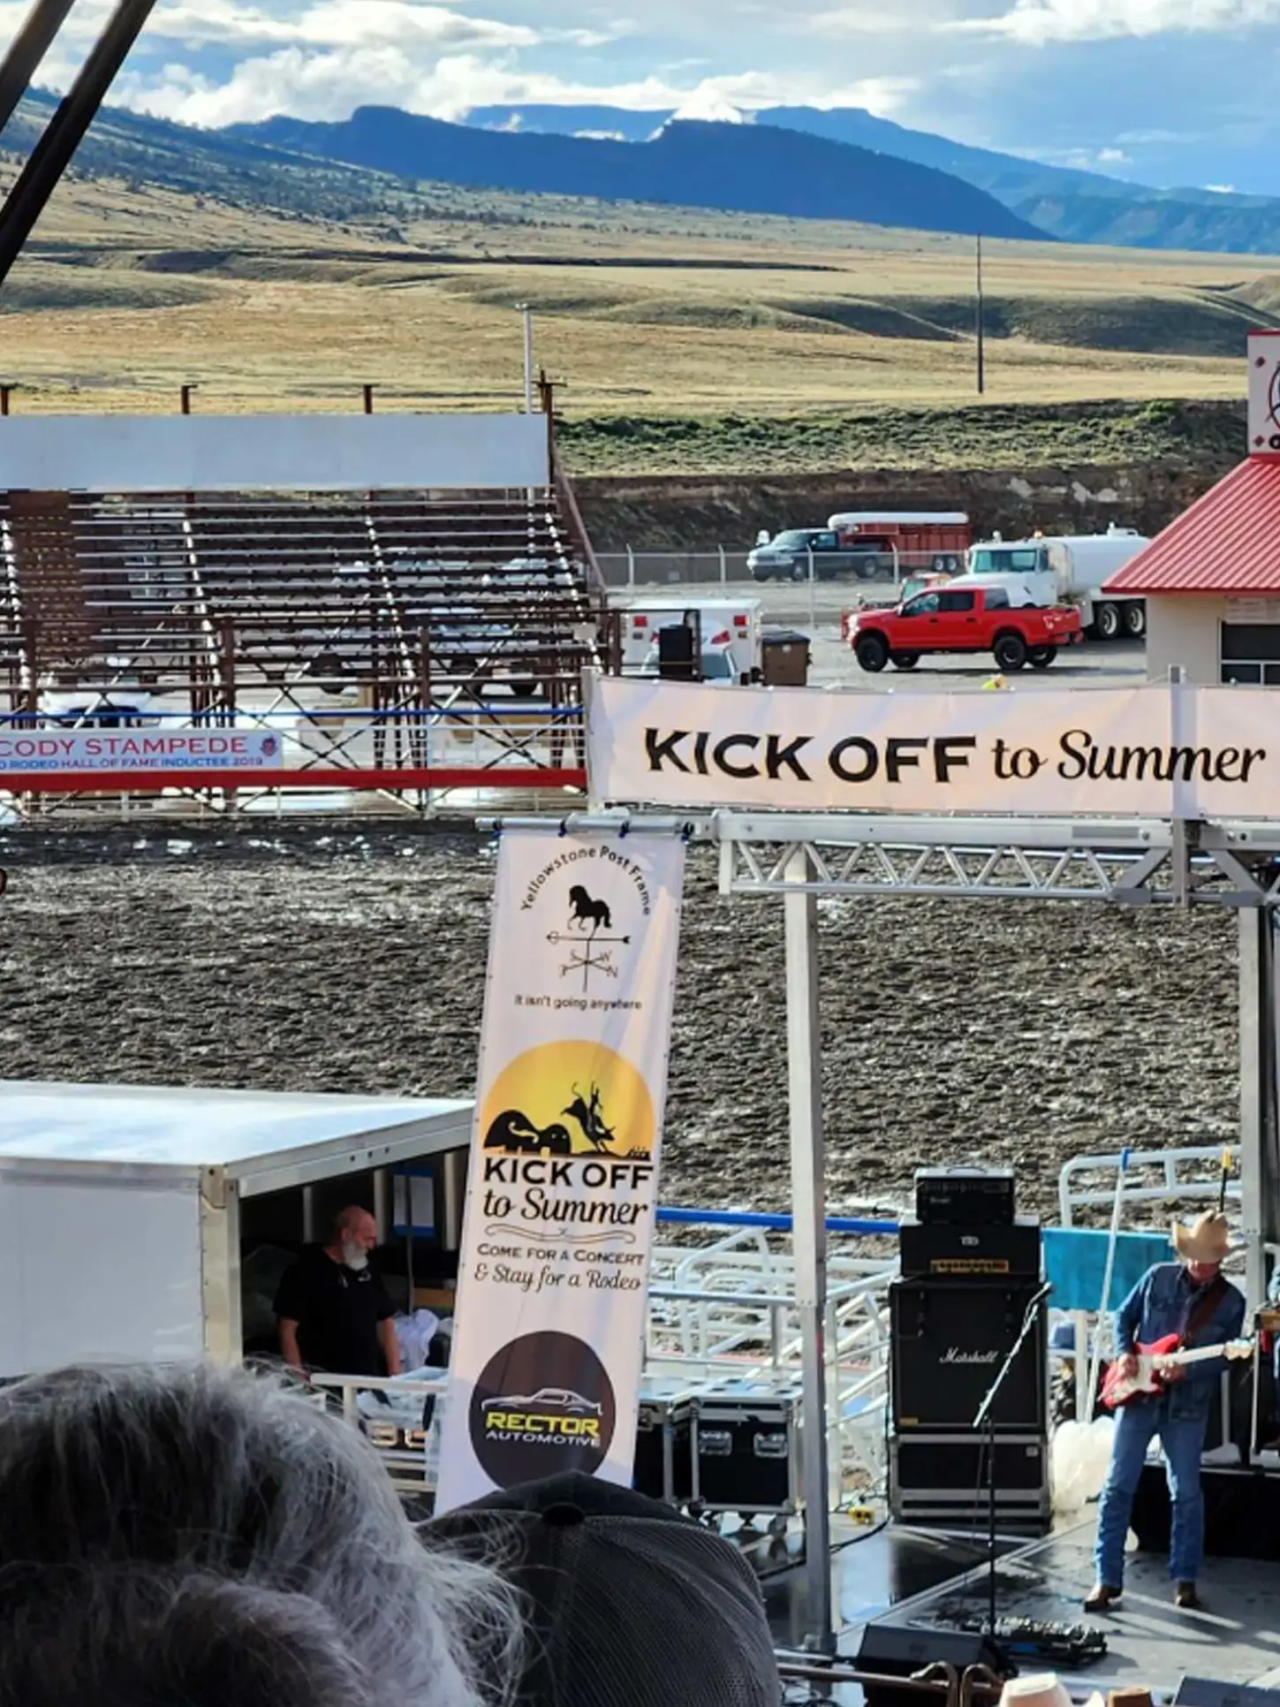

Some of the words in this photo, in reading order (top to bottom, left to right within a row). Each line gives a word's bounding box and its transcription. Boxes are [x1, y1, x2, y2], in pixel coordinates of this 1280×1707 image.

[85, 736, 249, 755] STAMPEDE
[645, 728, 813, 782] KICK
[828, 735, 978, 782] OFF
[992, 738, 1049, 780] to
[1058, 729, 1266, 782] Summer
[61, 758, 97, 769] HALL
[100, 758, 119, 768] OF
[121, 757, 160, 768] FAME
[161, 756, 230, 767] INDUCTEE
[520, 847, 596, 912] Yellowstone
[600, 846, 630, 870] Post
[628, 865, 651, 916] Frame
[525, 995, 551, 1006] isn't
[554, 998, 587, 1011] going
[590, 998, 642, 1011] anywhere
[484, 1158, 573, 1187] KICK
[582, 1163, 654, 1189] OFF
[483, 1188, 515, 1218] to
[521, 1187, 649, 1225] Summer
[477, 1243, 522, 1259] COME
[527, 1246, 556, 1260] FOR
[560, 1248, 570, 1261] A
[573, 1249, 645, 1266] CONCERT
[474, 1263, 489, 1280] &
[492, 1265, 534, 1292] Stay
[535, 1265, 564, 1293] for
[568, 1276, 581, 1288] a
[586, 1270, 641, 1291] Rodeo
[938, 1347, 998, 1364] Marshall
[485, 1411, 600, 1437] RECTOR
[485, 1430, 600, 1447] AUTOMOTIVE
